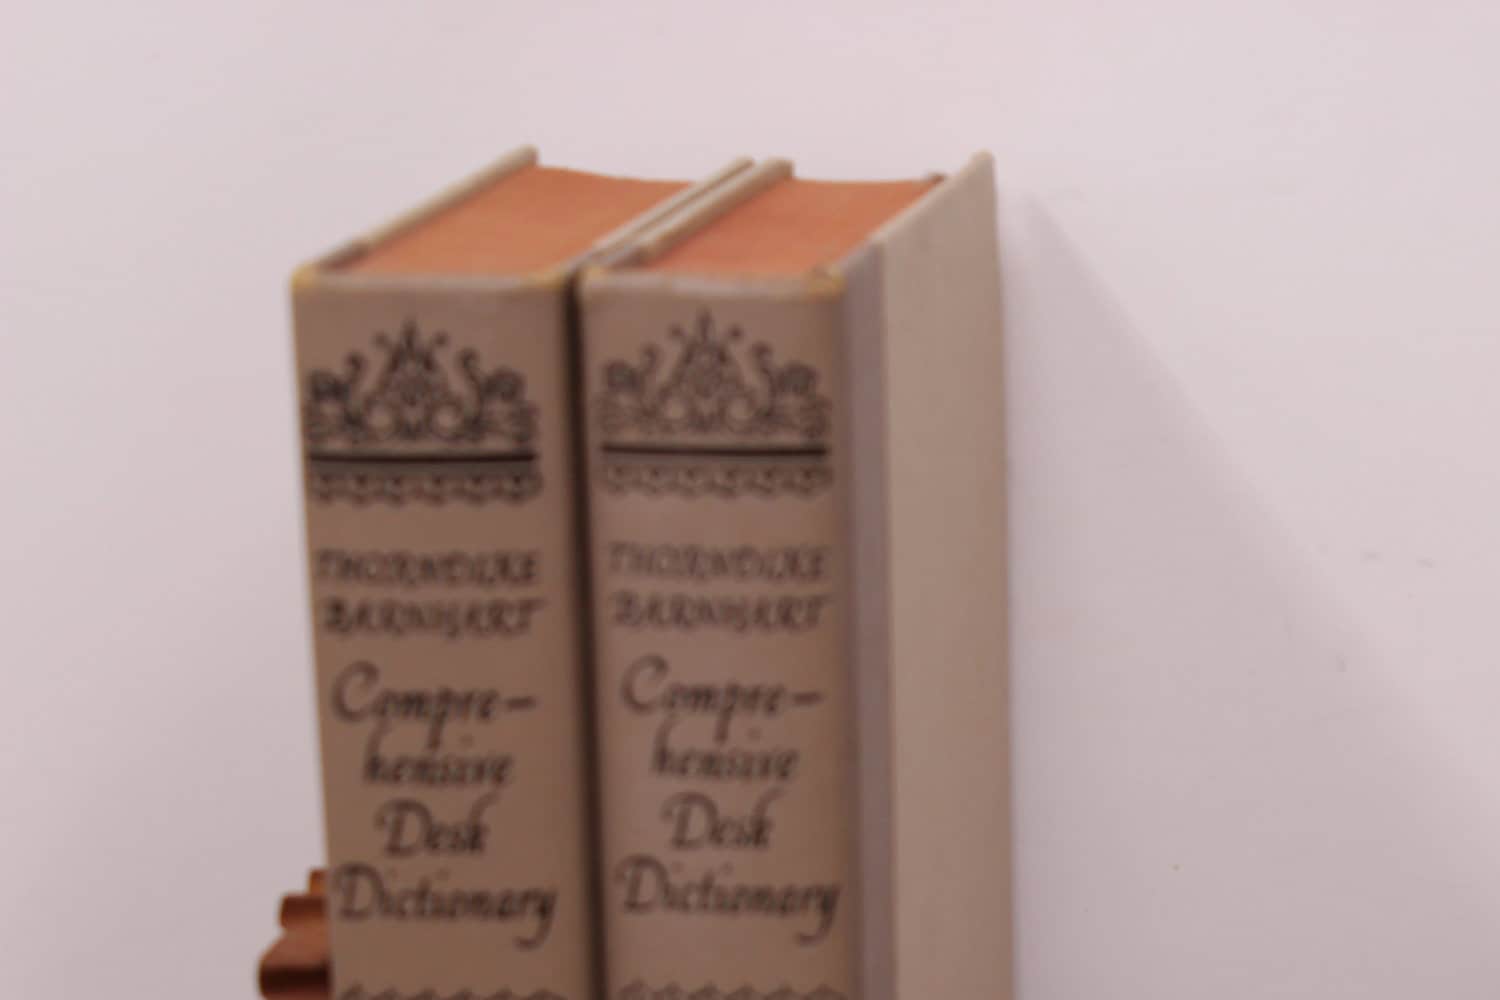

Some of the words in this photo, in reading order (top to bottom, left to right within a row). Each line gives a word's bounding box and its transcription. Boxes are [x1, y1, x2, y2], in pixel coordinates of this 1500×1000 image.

[330, 660, 538, 749] Compre-
[620, 654, 824, 743] Compre-
[362, 716, 514, 786] hensive
[652, 710, 801, 780] hensive
[373, 793, 500, 857] Desk
[659, 787, 789, 850] Desk
[331, 861, 560, 950] Dictionary
[613, 853, 843, 946] Dictionary
